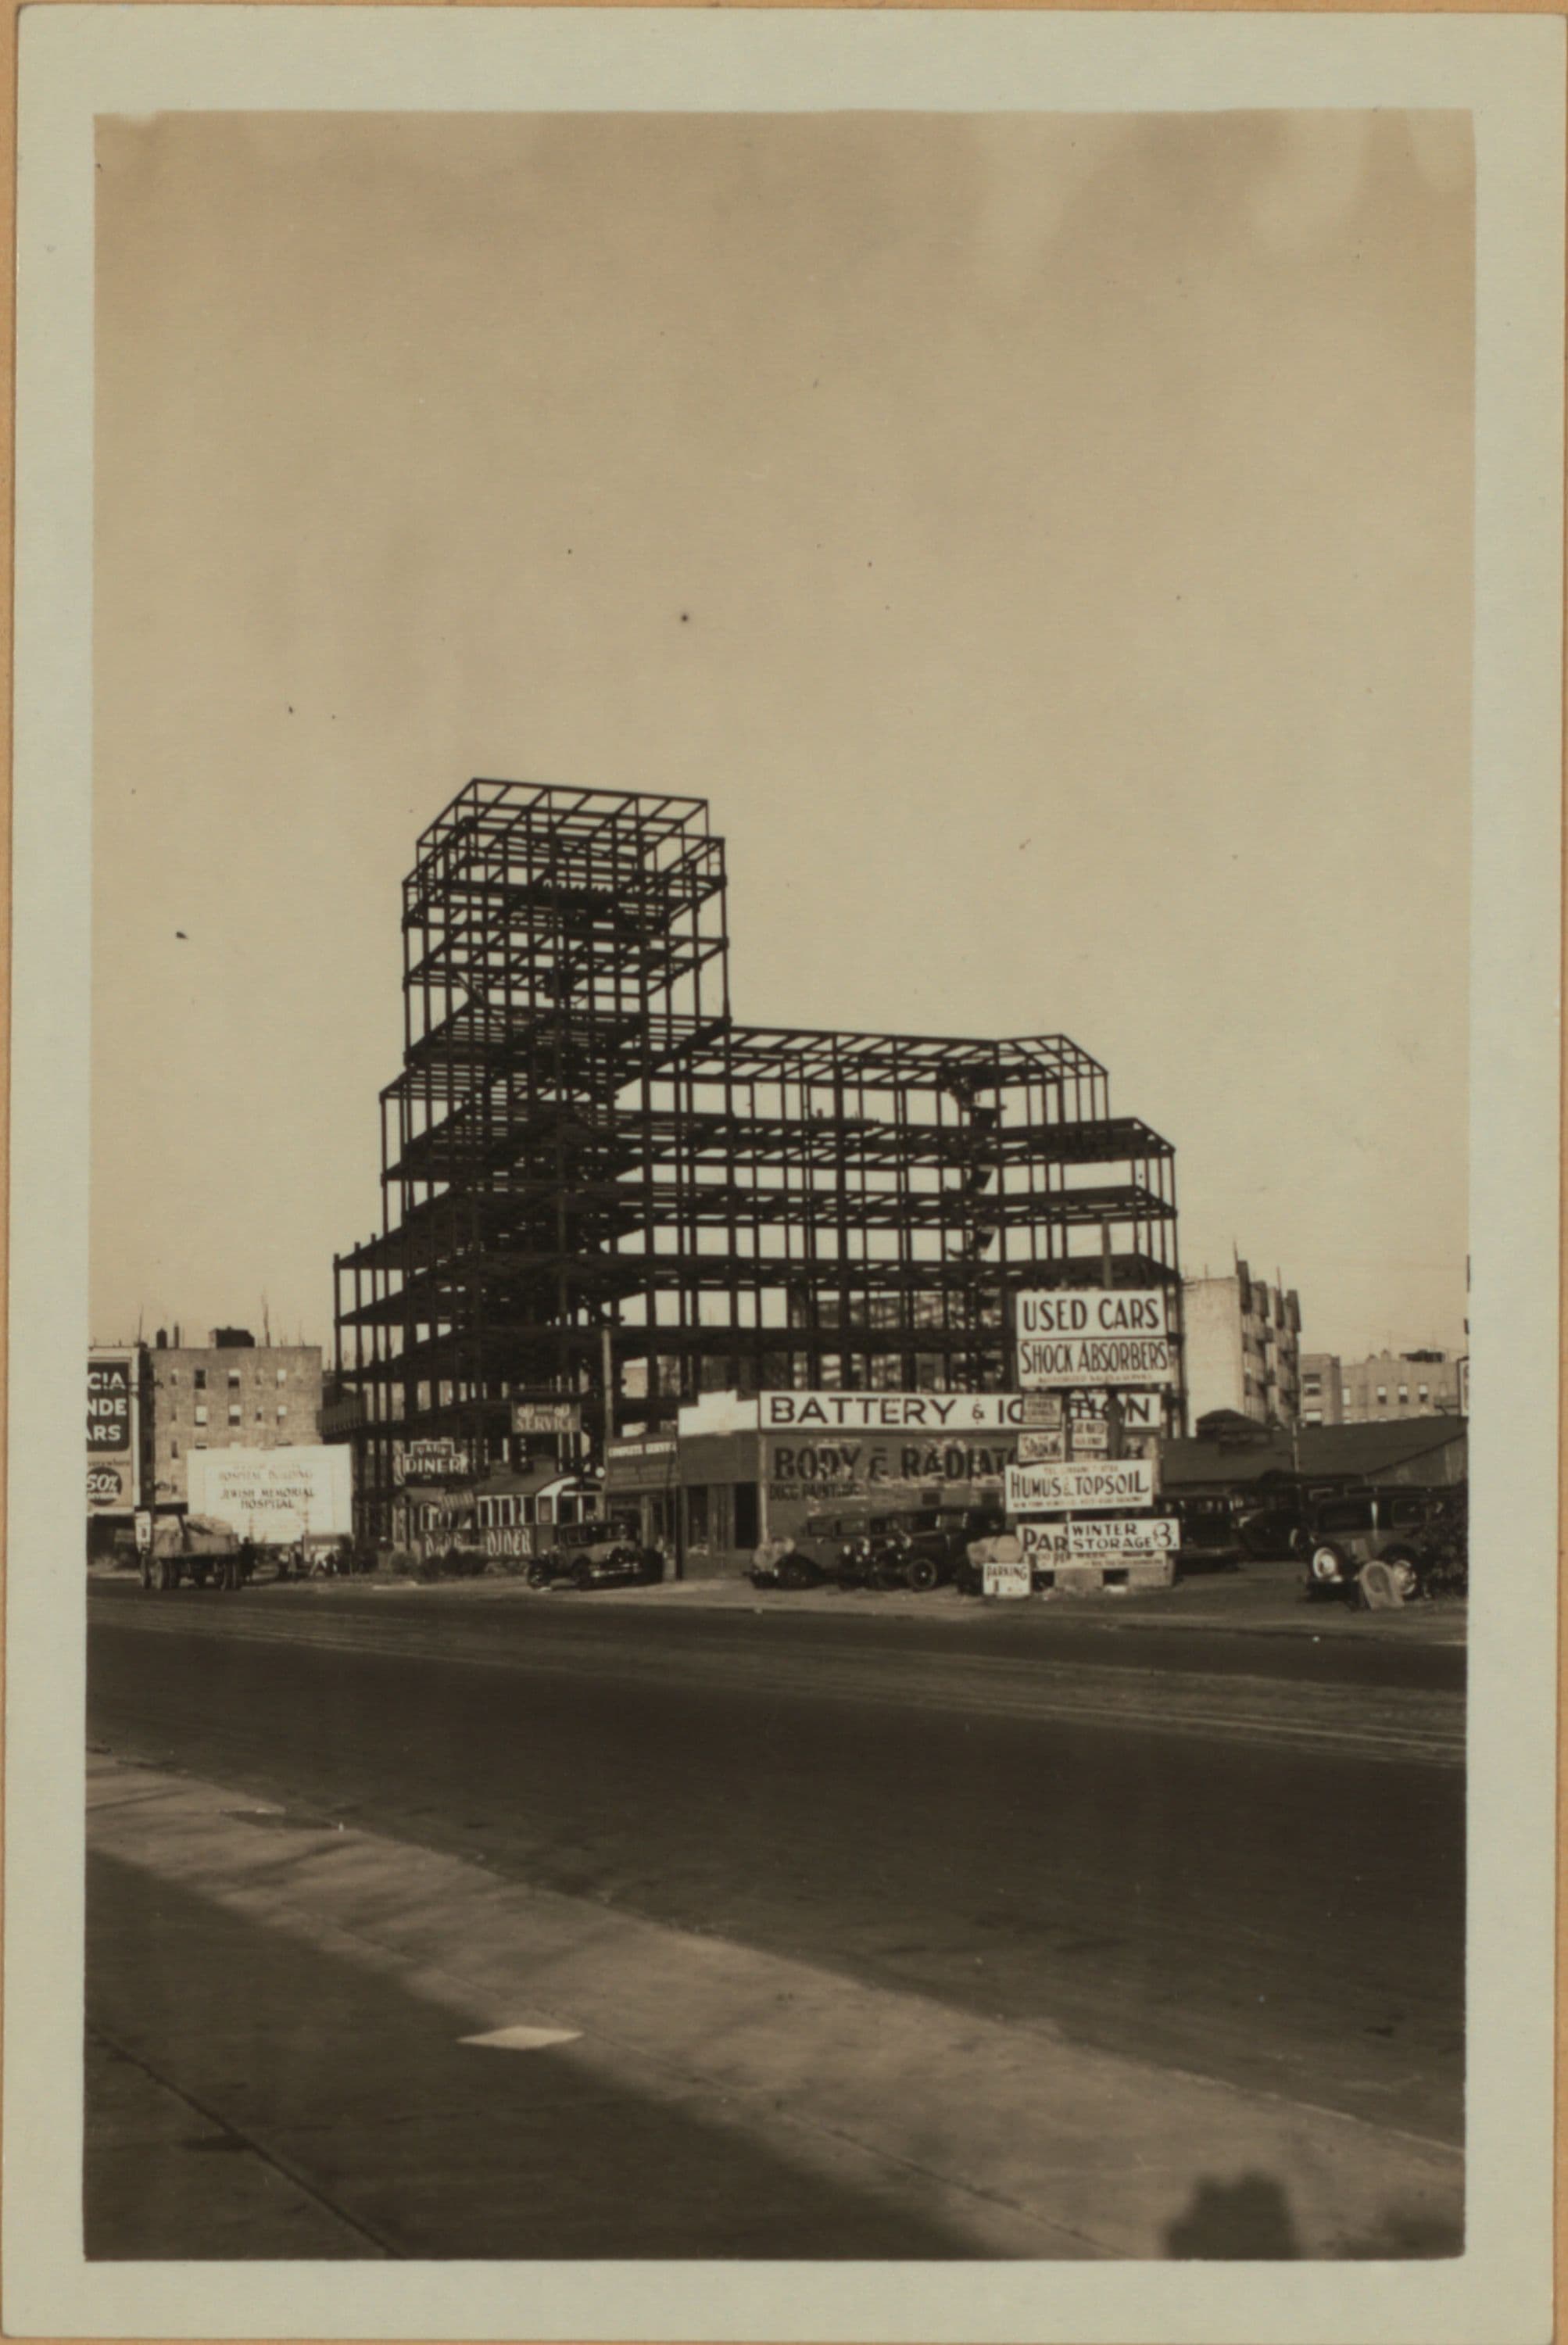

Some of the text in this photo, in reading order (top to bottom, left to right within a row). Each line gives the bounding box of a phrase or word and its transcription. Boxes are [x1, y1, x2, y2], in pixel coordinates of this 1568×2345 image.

[1023, 1298, 1160, 1332] USED CARS
[1021, 1341, 1168, 1374] SHOCK ABSORBERS
[770, 1396, 957, 1425] BATTERY
[404, 1457, 462, 1473] DINER
[774, 1446, 861, 1480] BODY
[220, 1488, 315, 1499] JEWISH MEMORIAL
[1011, 1472, 1062, 1498] HUMUS
[1075, 1469, 1150, 1496] TOPSOIL
[241, 1498, 295, 1509] HOSPITAL
[1072, 1523, 1138, 1536] WINTER
[487, 1527, 532, 1557] DINER
[1072, 1536, 1152, 1551] STORAGE
[986, 1564, 1028, 1580] PARKING
